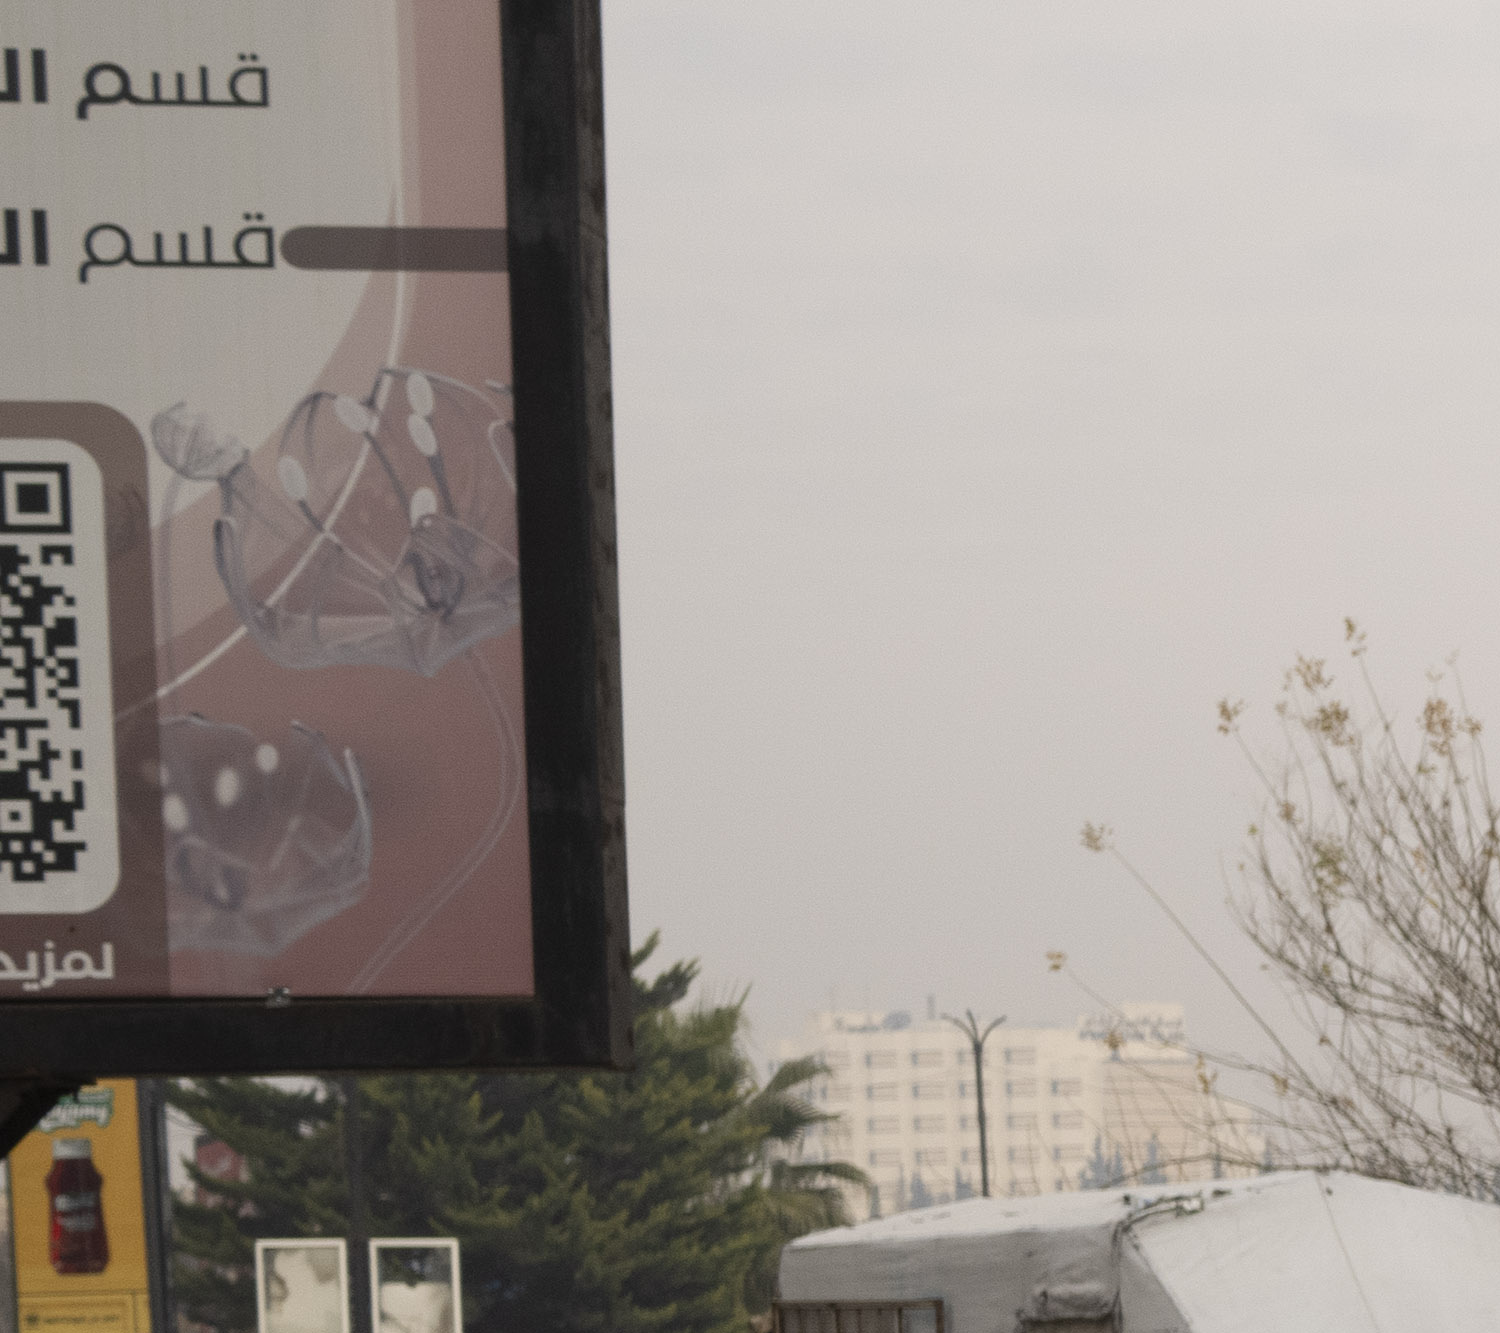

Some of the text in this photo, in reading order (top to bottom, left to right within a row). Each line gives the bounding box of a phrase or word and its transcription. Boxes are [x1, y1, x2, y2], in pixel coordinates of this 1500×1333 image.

[0, 48, 269, 120] قسم ال
[0, 208, 275, 284] قسم ال
